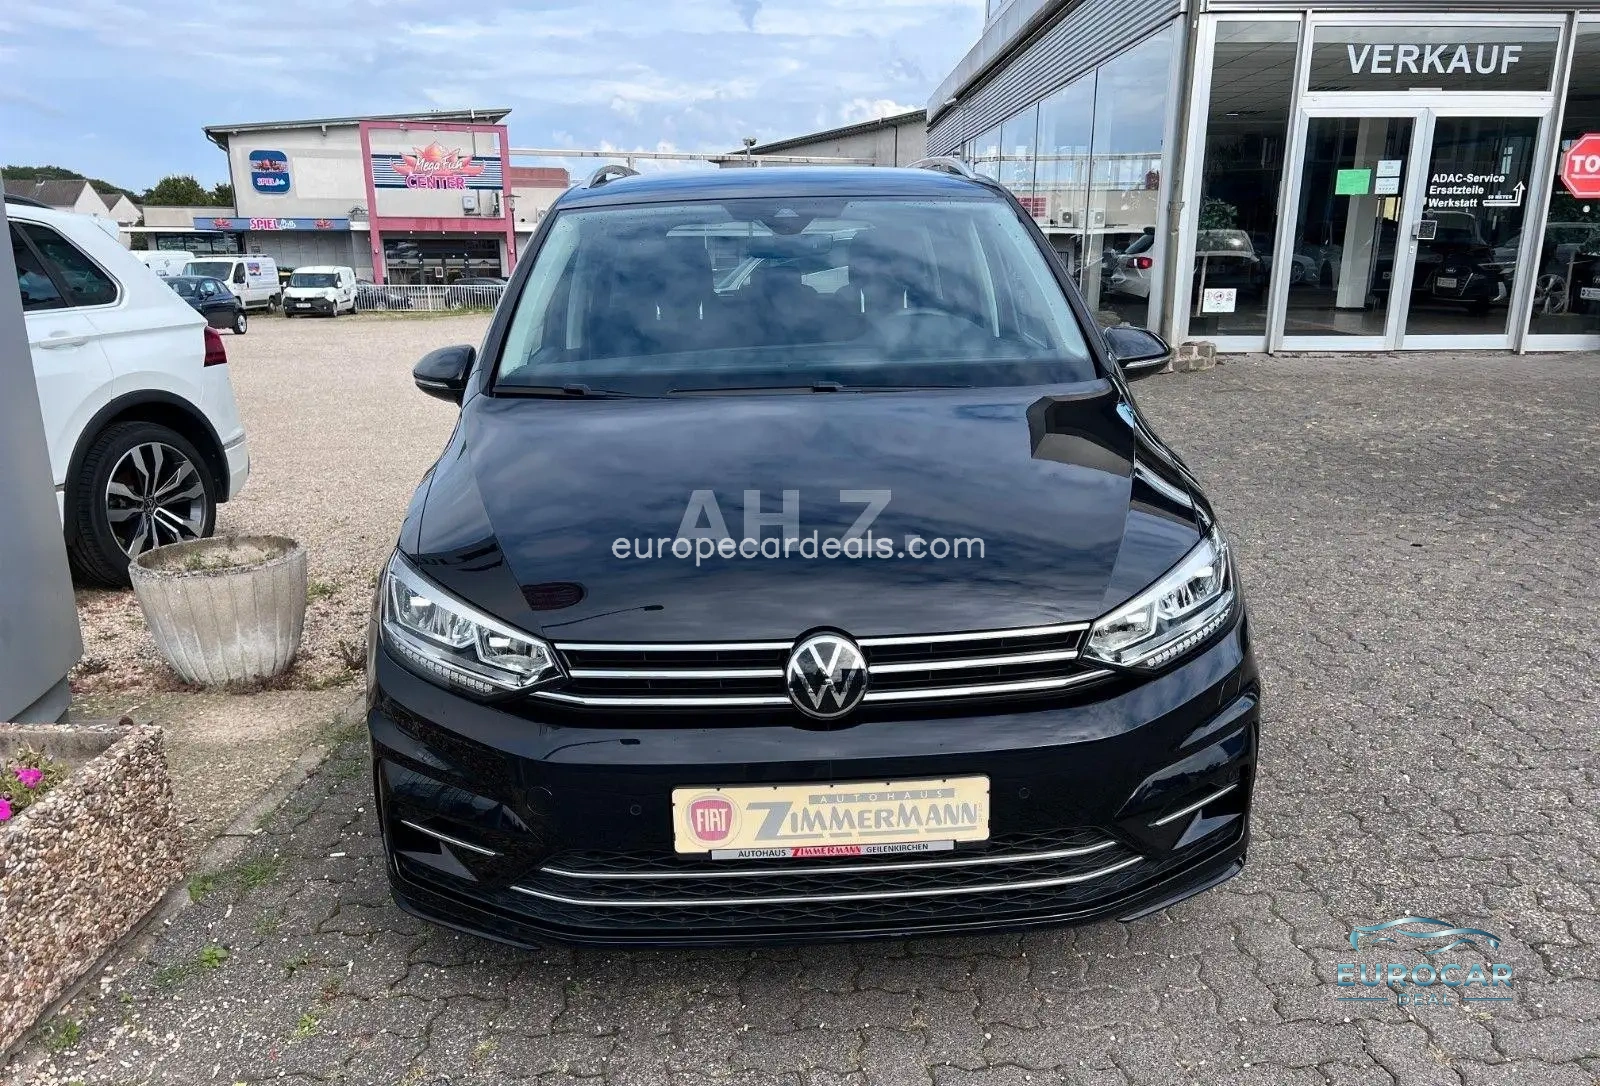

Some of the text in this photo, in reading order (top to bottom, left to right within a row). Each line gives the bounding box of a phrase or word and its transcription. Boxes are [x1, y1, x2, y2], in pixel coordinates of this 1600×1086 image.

[1347, 44, 1523, 75] VERKAUF
[414, 157, 464, 177] Mega Fun
[406, 174, 466, 190] CENTER
[1431, 173, 1506, 184] ADAC-Service
[1429, 185, 1485, 195] Ersatzteile
[1428, 198, 1478, 208] Werkstatt
[250, 218, 280, 230] SPIEL
[818, 789, 946, 805] AUTOHAUS
[696, 808, 728, 833] FIAT
[746, 801, 978, 841] ZIMMERMANN
[737, 842, 929, 859] AUTOHAUS ZIMMERMANN GEILENKIRCHEN
